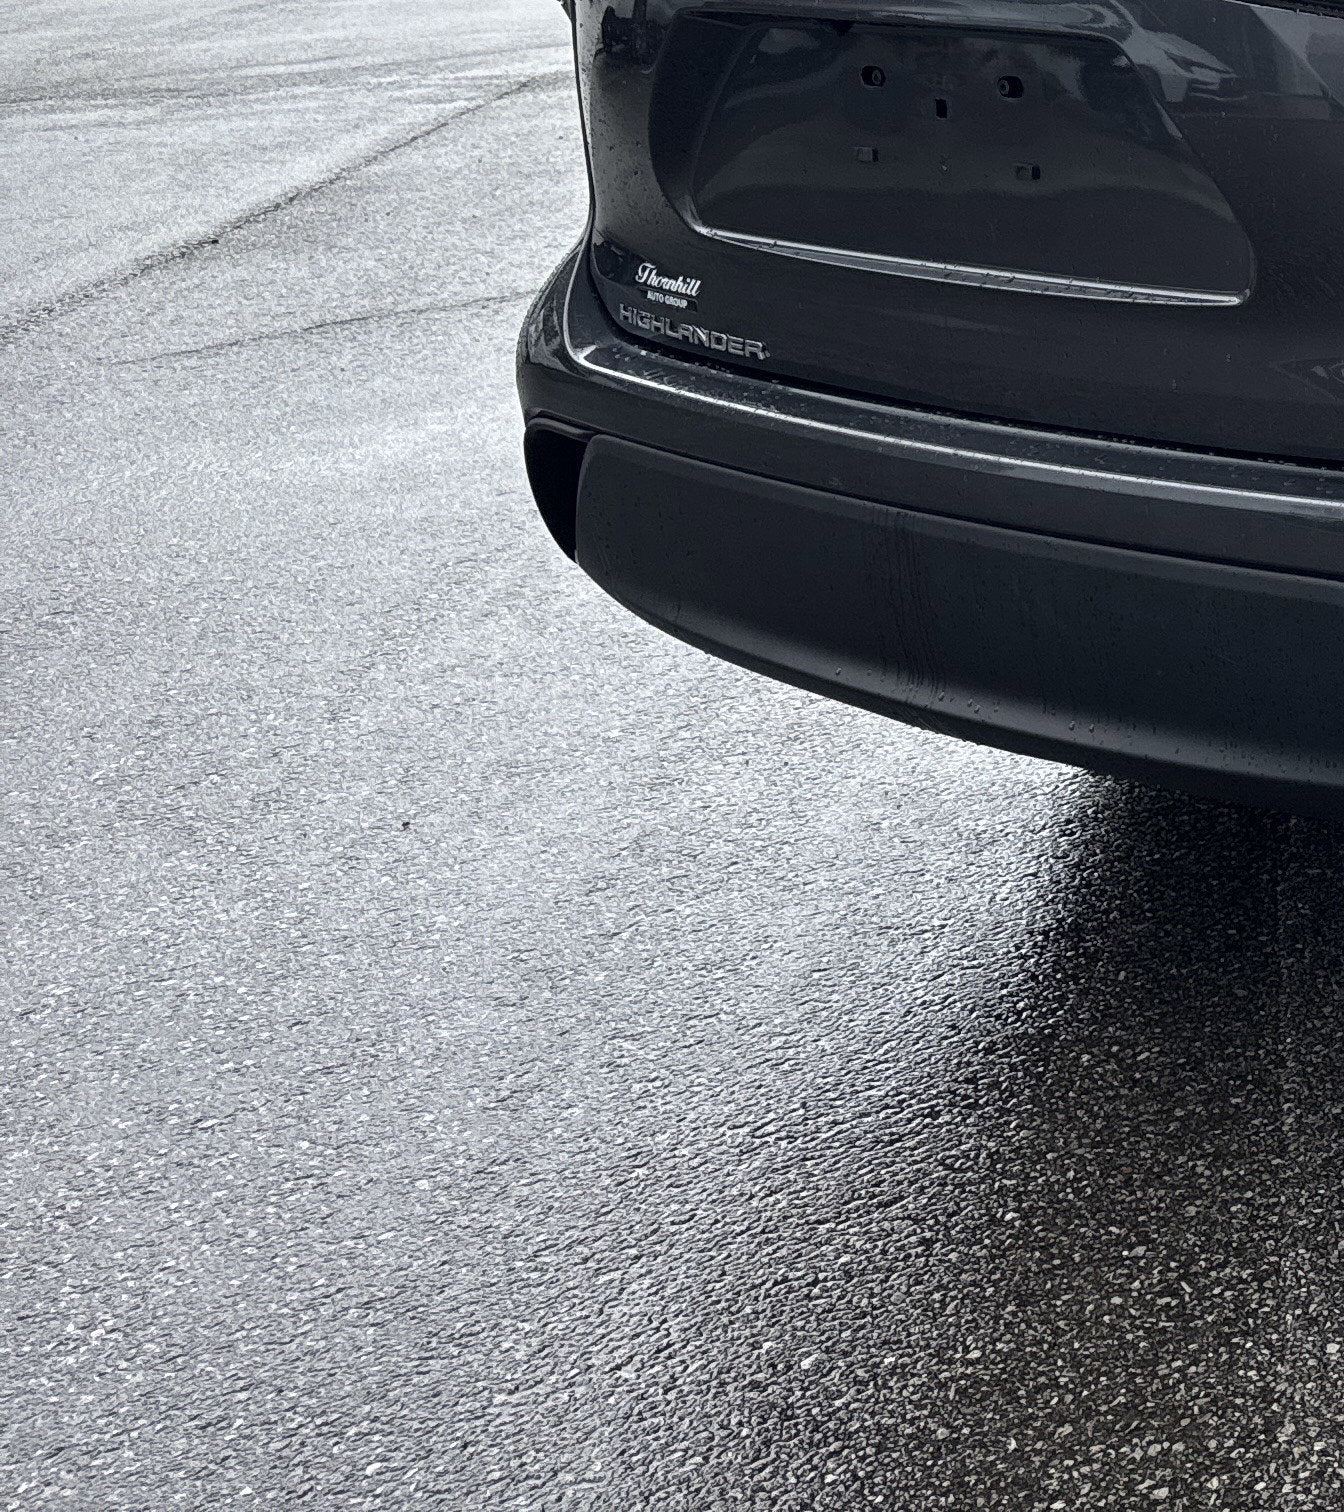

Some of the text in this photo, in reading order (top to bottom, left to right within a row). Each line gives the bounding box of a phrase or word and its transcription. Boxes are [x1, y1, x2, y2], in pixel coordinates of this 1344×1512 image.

[635, 262, 701, 297] Thornhill
[647, 290, 688, 309] AUTO GROUP
[619, 303, 767, 361] HIGHLANDER
